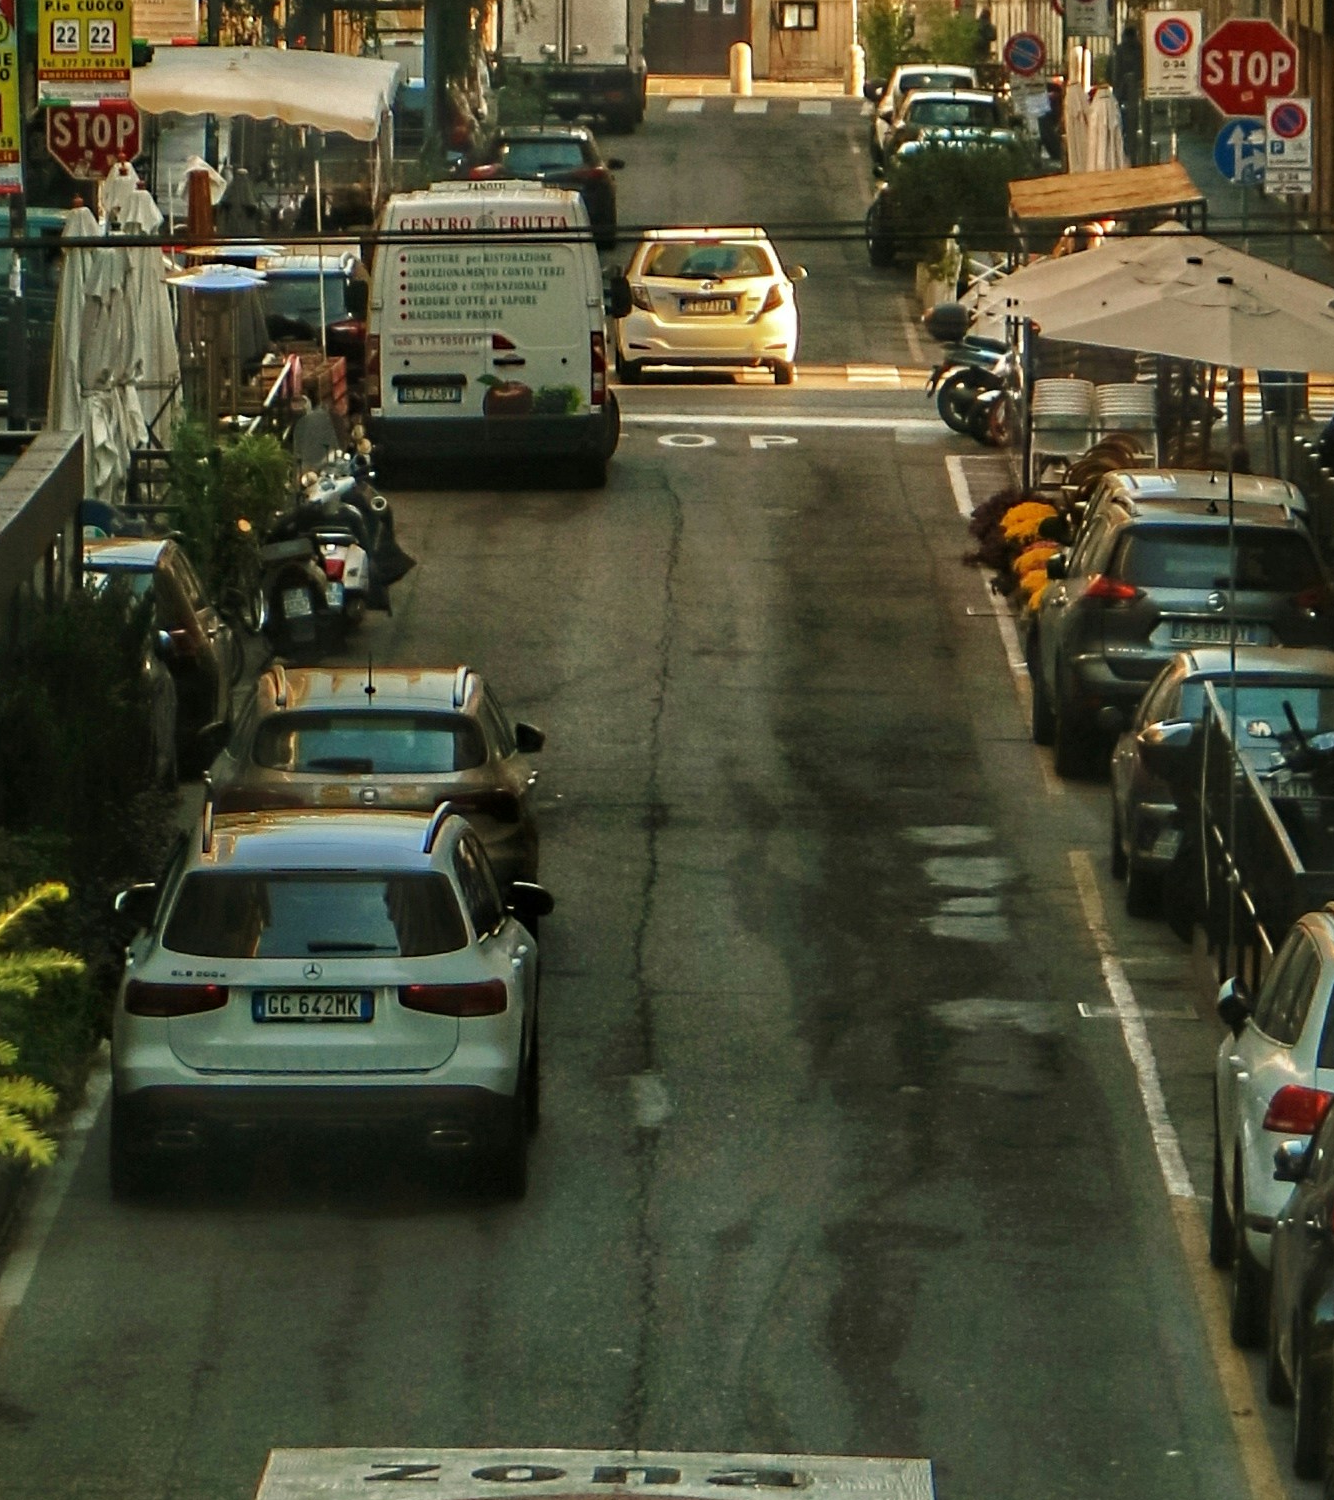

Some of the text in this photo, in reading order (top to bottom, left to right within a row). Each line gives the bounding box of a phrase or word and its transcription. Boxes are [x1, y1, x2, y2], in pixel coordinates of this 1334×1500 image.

[77, 0, 124, 12] CUOCO
[56, 26, 111, 44] 22 22
[1205, 49, 1291, 87] STOP
[53, 111, 135, 148] STOP
[400, 215, 568, 231] CENTRO FRUTTA
[657, 433, 799, 449] OP
[268, 995, 360, 1015] GG 642MK
[364, 1463, 809, 1488] zona
